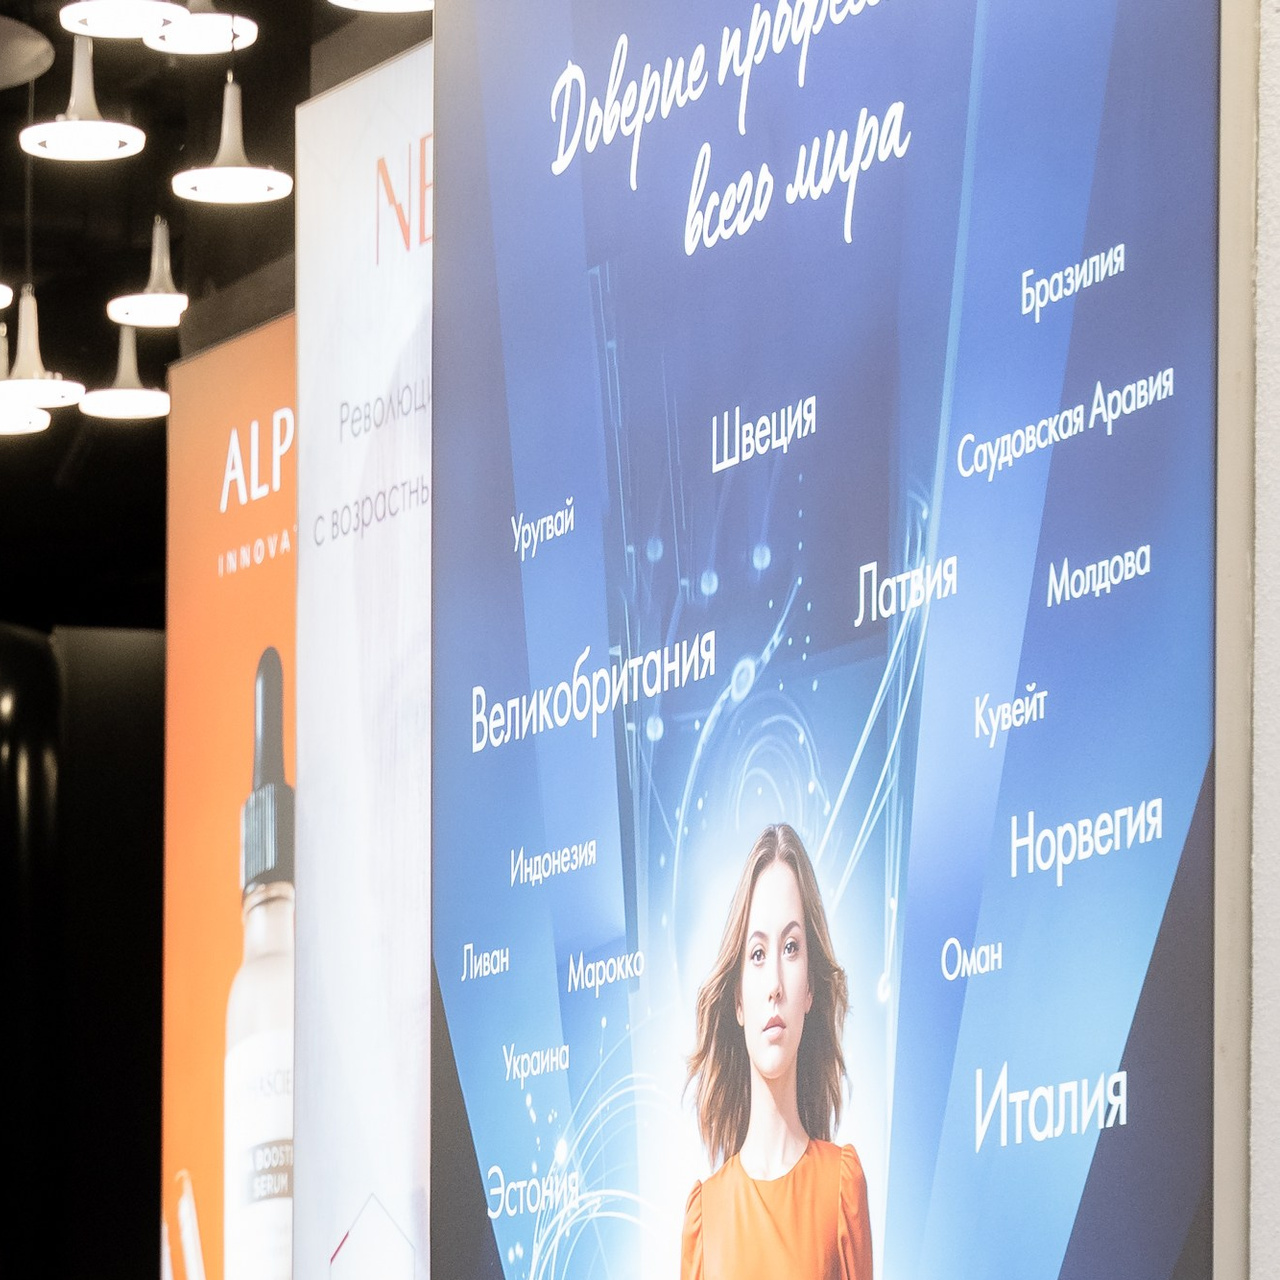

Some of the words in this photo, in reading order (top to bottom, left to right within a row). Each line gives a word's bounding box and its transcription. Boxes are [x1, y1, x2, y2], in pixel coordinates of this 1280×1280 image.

[550, 33, 709, 190] Доверие
[684, 142, 774, 256] всего
[785, 100, 912, 243] мира
[1022, 243, 1126, 322] Бразилия
[339, 375, 430, 444] Революц
[712, 396, 817, 475] Швеция
[958, 400, 1084, 481] Саудовская
[1091, 367, 1174, 434] Аравия
[220, 407, 295, 513] ALP
[218, 525, 297, 577] INNOVA
[511, 498, 575, 562] Уругвай
[855, 555, 958, 629] Латвия
[1047, 541, 1151, 608] Молдова
[471, 629, 717, 754] Великобритания
[975, 683, 1048, 749] Кувейт
[510, 838, 596, 887] Индонезия
[1011, 797, 1163, 887] Норвегия
[462, 943, 509, 983] Ливан
[568, 949, 645, 999] Марокко
[942, 937, 1003, 982] Оман
[502, 1042, 570, 1083] Украина
[976, 1061, 1128, 1151] Италия
[486, 1165, 579, 1220] Эстония
